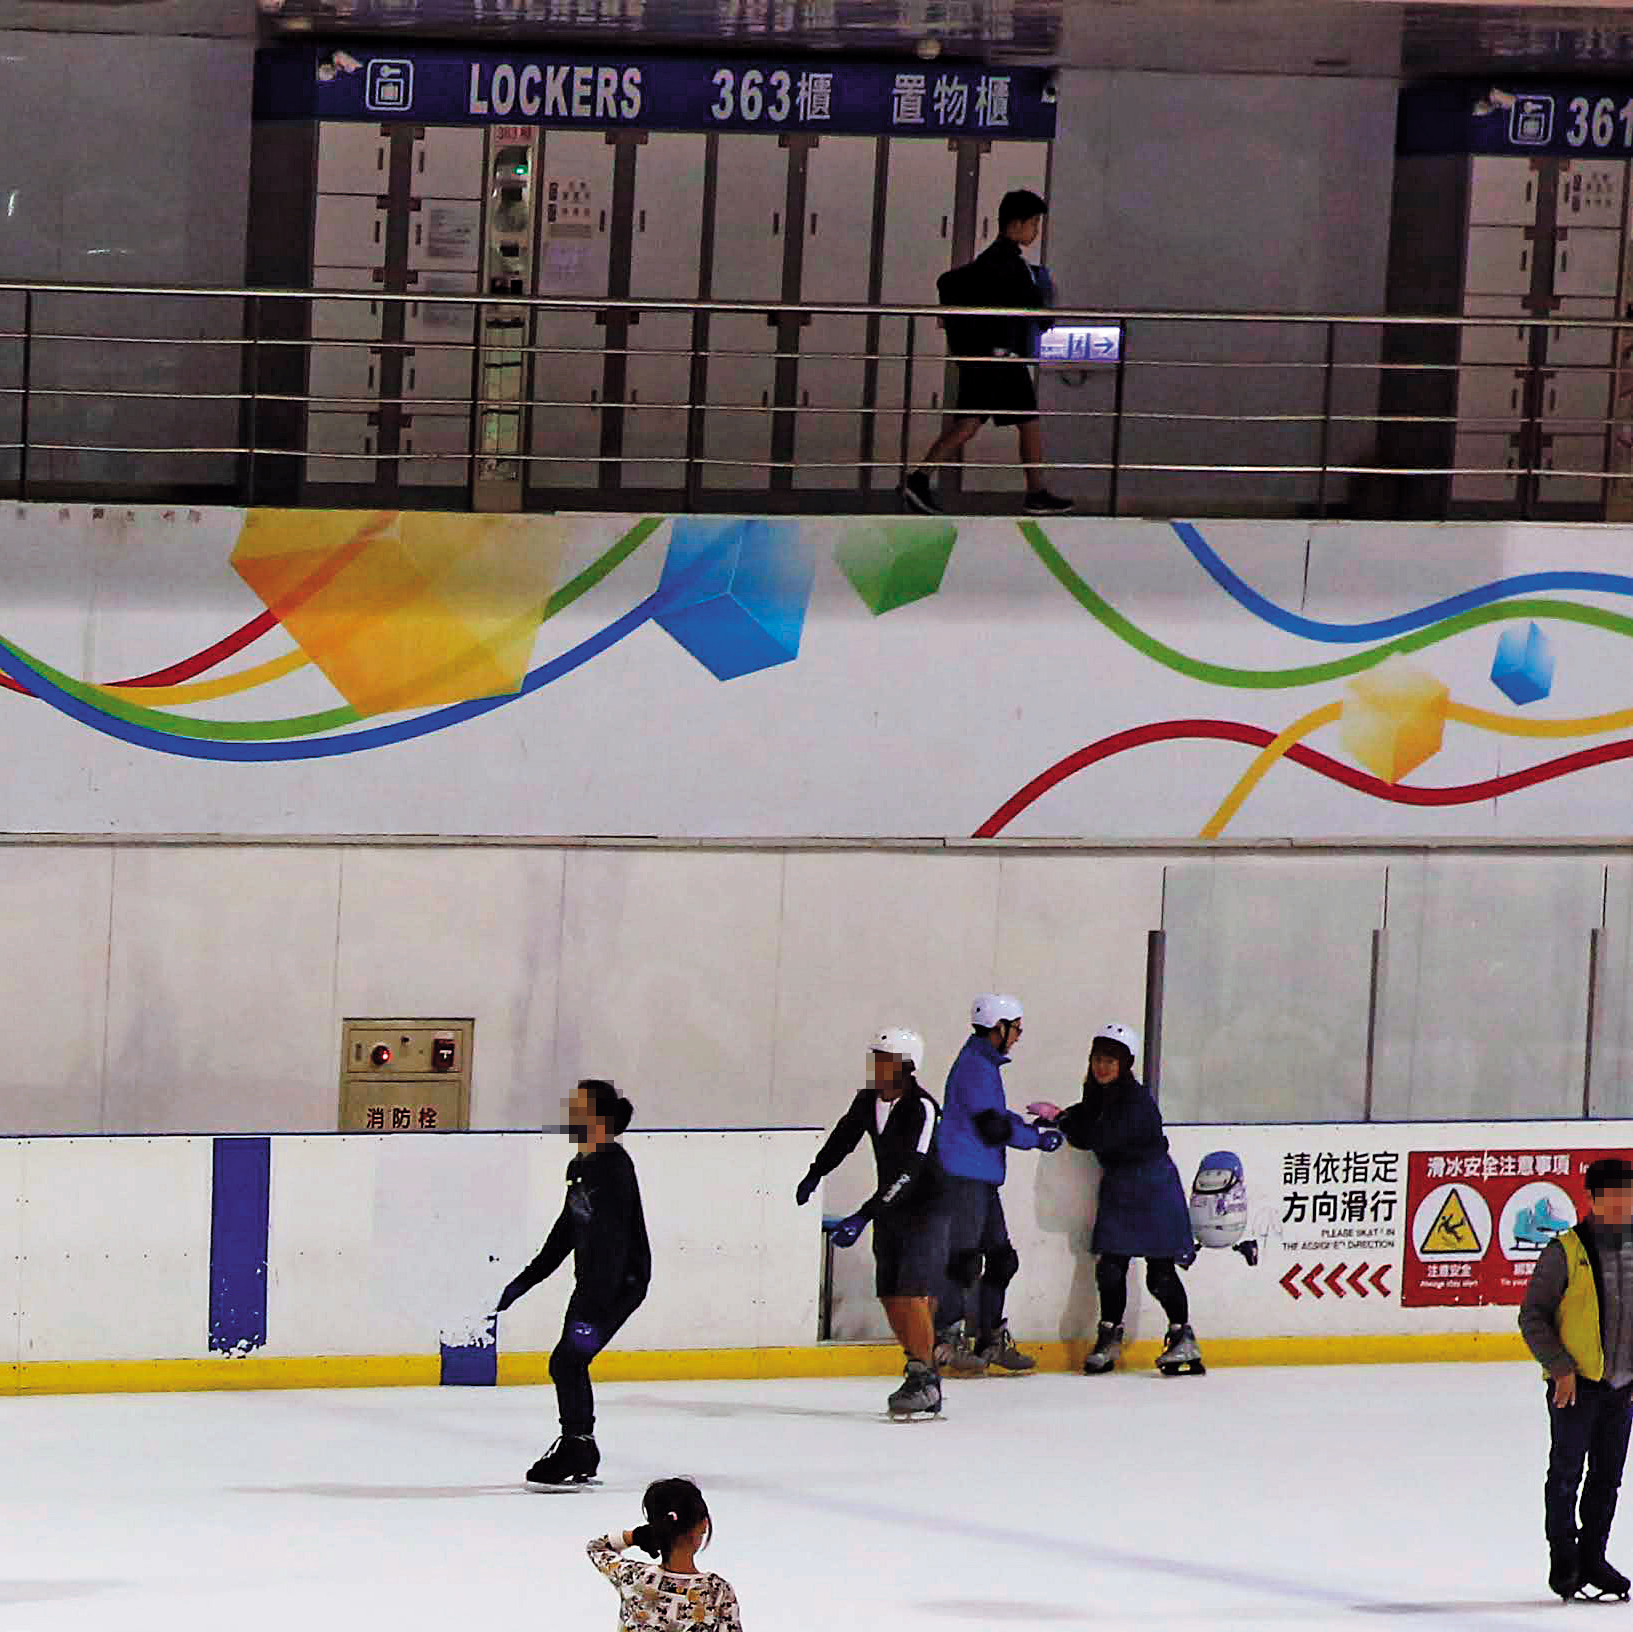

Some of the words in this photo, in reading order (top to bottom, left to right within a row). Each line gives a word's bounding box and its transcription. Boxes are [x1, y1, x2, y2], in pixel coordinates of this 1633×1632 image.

[468, 63, 642, 118] LOCKERS
[711, 70, 833, 122] 363櫃
[892, 73, 1011, 126] 置物櫃
[365, 1107, 439, 1129] 消防栓
[1283, 1150, 1399, 1184] 請依指定
[1282, 1190, 1398, 1223] 方向滑行
